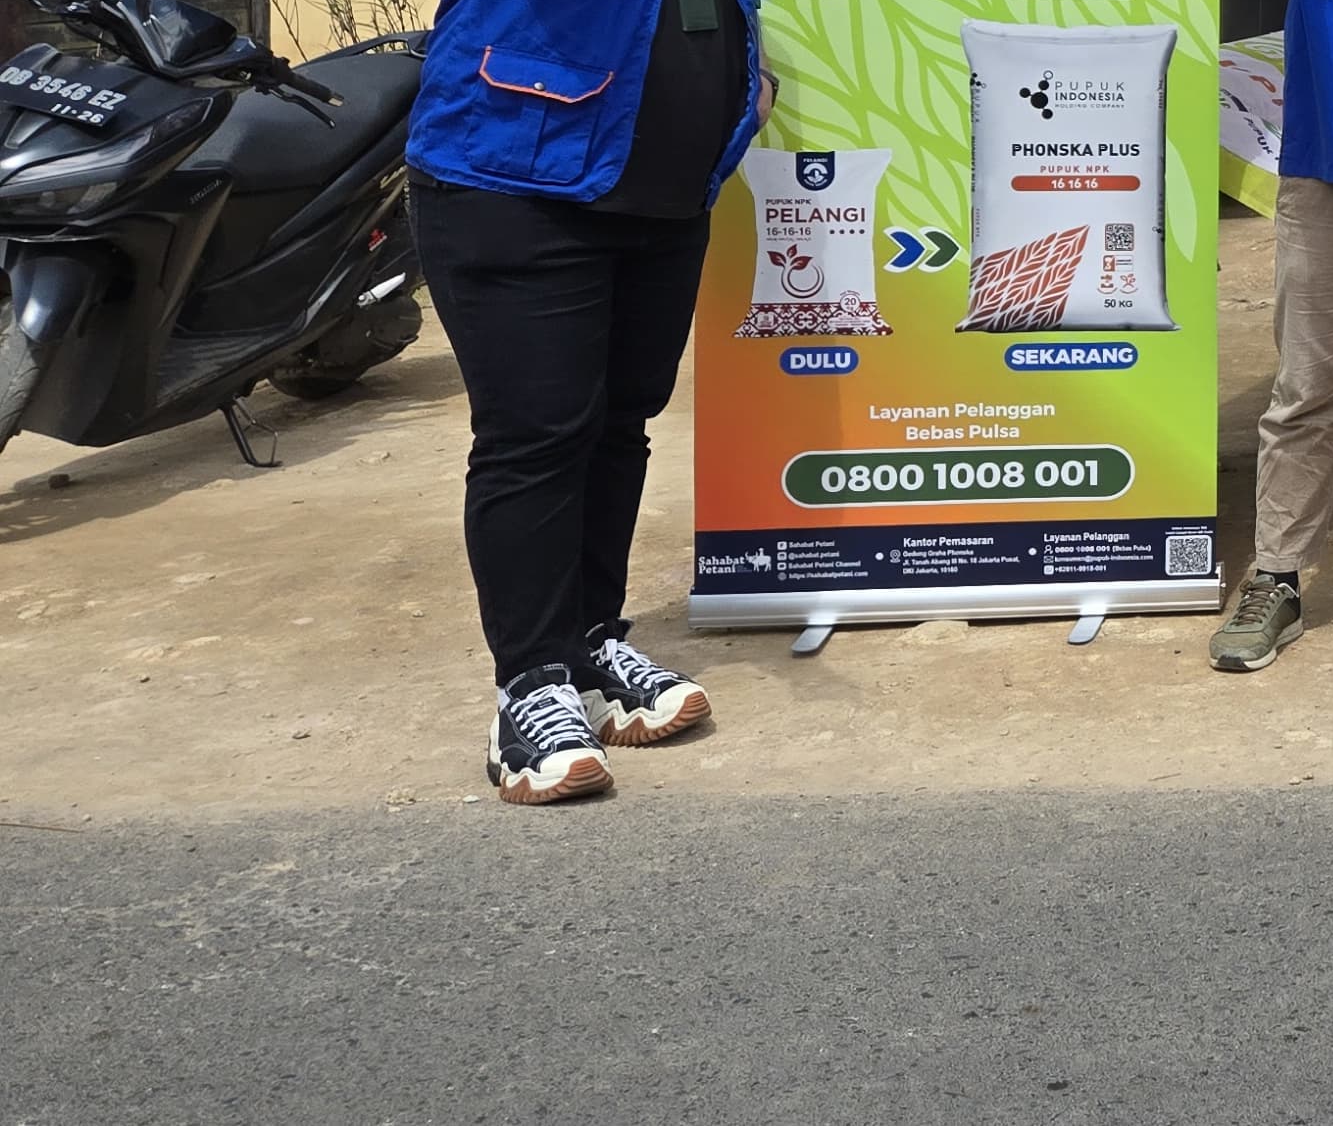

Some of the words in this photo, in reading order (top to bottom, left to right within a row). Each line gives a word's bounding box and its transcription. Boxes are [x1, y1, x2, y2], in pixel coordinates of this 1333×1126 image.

[1055, 82, 1124, 90] PUPUK
[30, 75, 92, 100] 3546
[88, 90, 127, 110] EZ
[1055, 92, 1124, 101] INDONESIA
[1012, 143, 1093, 156] PHONSKA
[1099, 144, 1140, 156] PLUS
[1086, 165, 1110, 173] NPK
[1051, 178, 1064, 189] 16
[1068, 178, 1081, 189] 16
[1085, 178, 1098, 189] 16
[766, 208, 865, 223] PELANGI
[766, 227, 811, 236] 16-16-16
[1104, 299, 1116, 308] 50
[1119, 300, 1132, 308] KG
[789, 351, 851, 369] DULU
[1011, 347, 1133, 366] SEKARANG
[869, 405, 951, 423] Layanan
[955, 402, 1055, 421] Pelanggan
[906, 425, 963, 440] Bebas
[969, 424, 1020, 438] Pulsa
[821, 463, 924, 493] 0800
[933, 462, 1025, 490] 1008
[1034, 460, 1098, 488] 001
[904, 538, 937, 547] Kantor
[939, 537, 994, 546] Pemasaran
[1044, 533, 1081, 543] Layanan
[1083, 532, 1129, 542] Pelanggan
[699, 555, 745, 566] Sahabat
[699, 564, 736, 574] Petani
